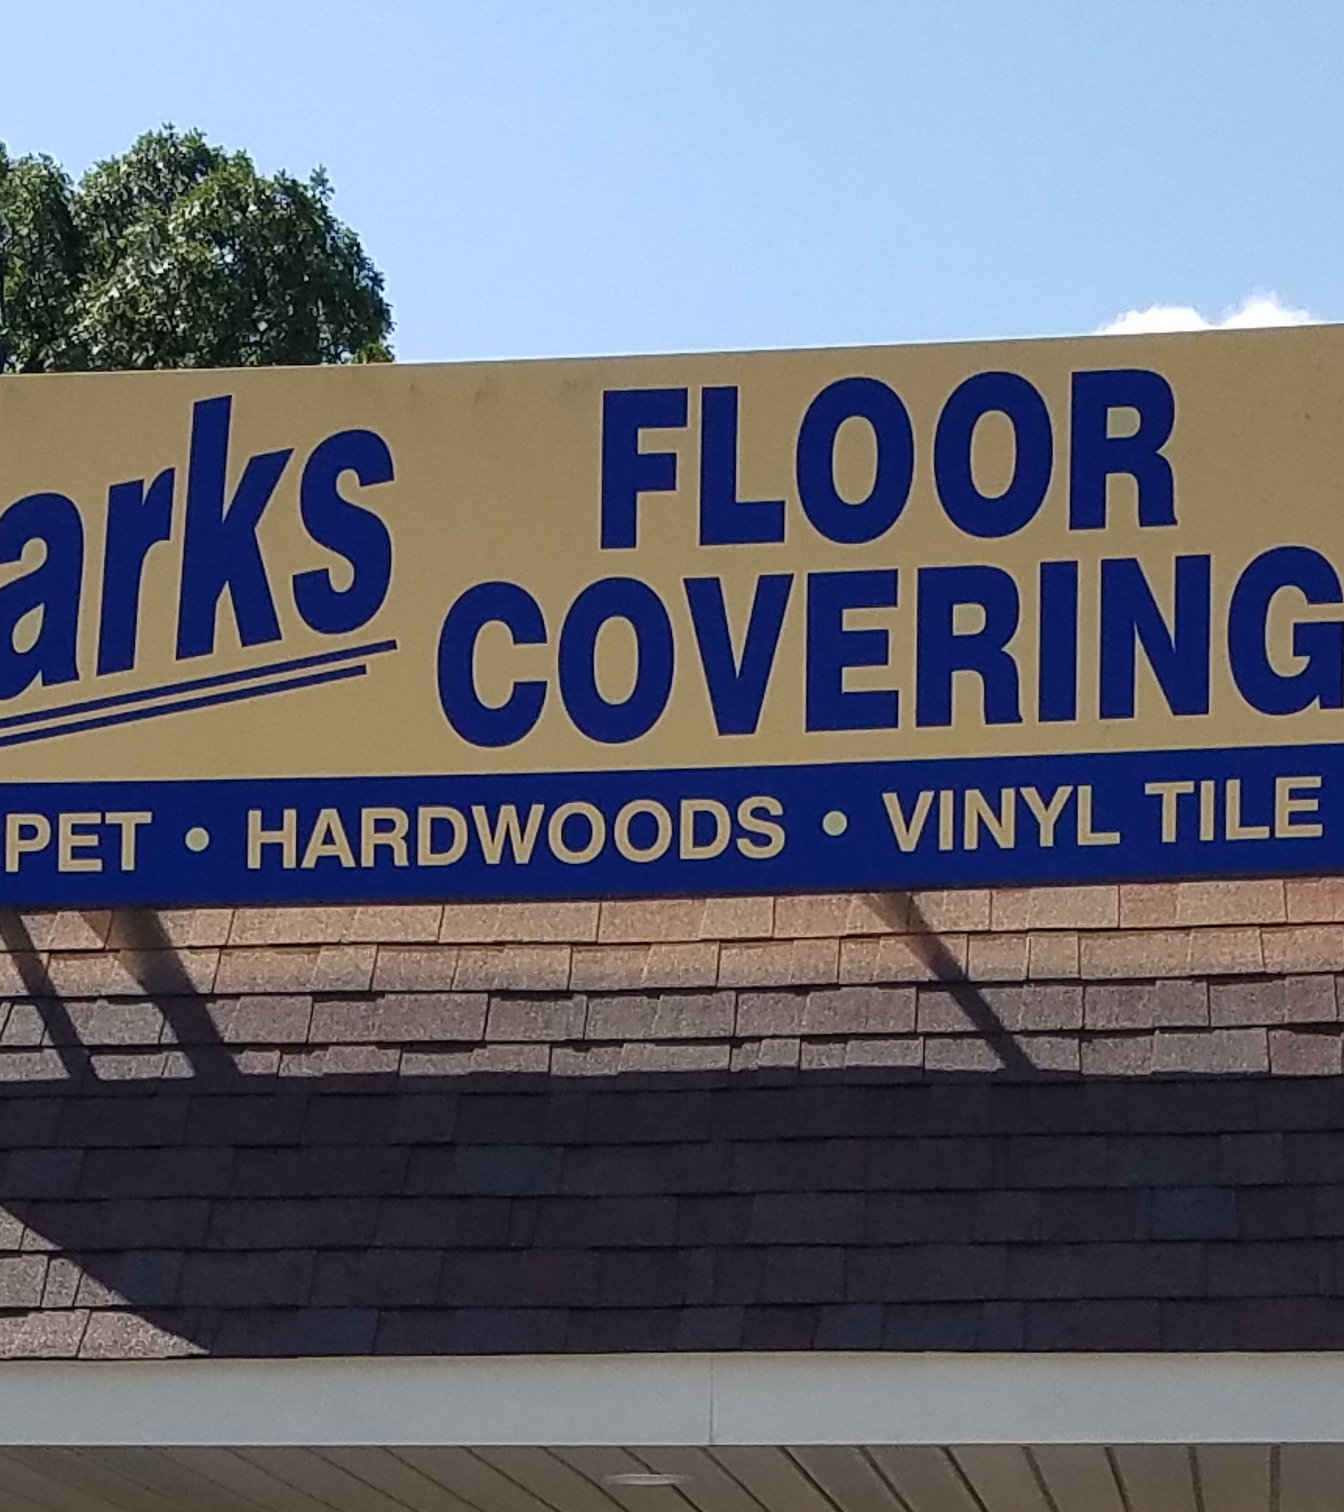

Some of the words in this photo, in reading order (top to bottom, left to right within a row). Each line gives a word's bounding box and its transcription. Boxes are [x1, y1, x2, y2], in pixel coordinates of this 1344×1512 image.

[600, 369, 1177, 548] FLOOR
[246, 796, 787, 869] HARDWOODS
[882, 785, 1122, 852] VINYL
[1145, 776, 1324, 842] TILE
